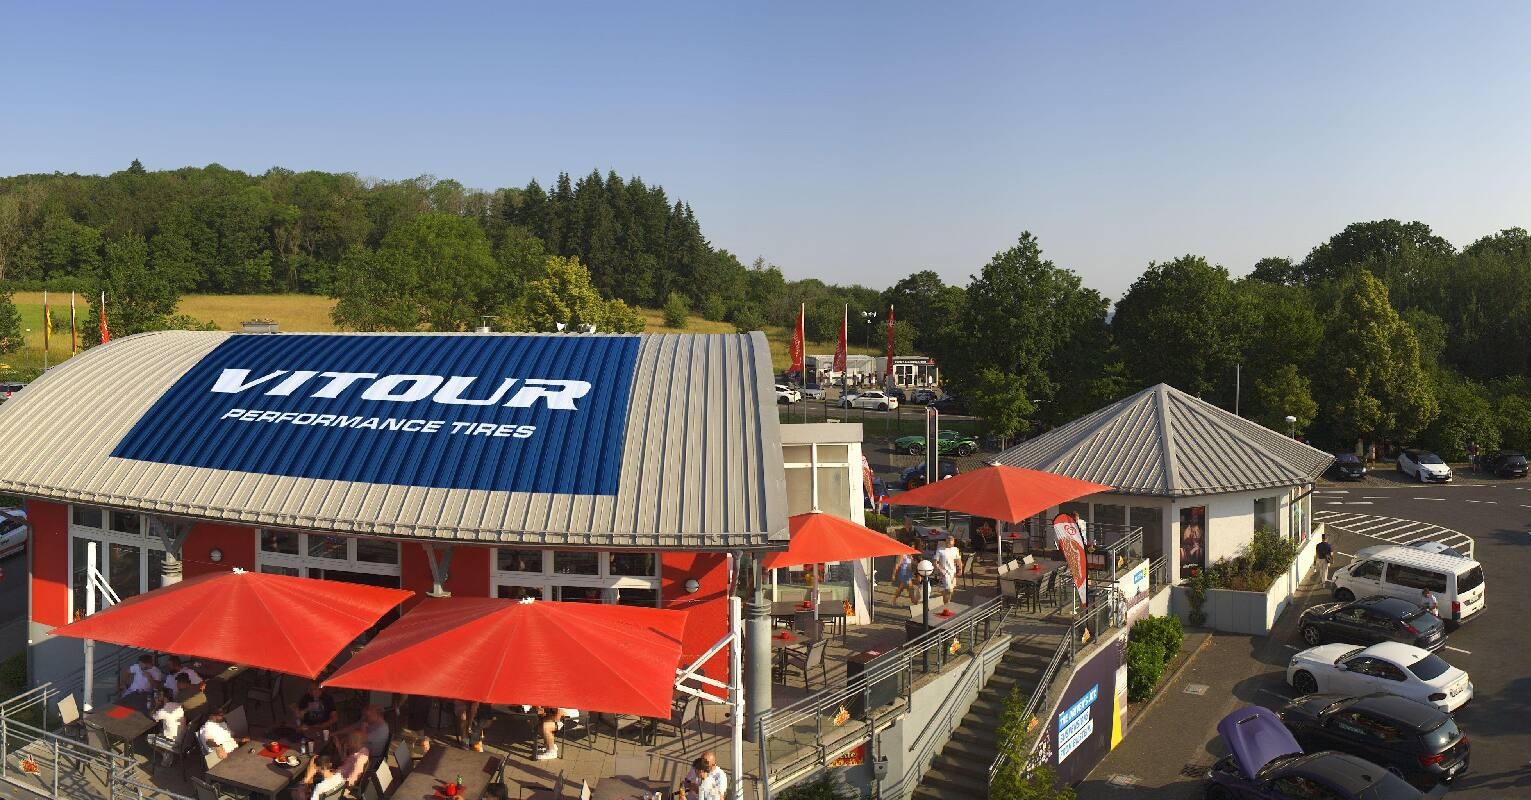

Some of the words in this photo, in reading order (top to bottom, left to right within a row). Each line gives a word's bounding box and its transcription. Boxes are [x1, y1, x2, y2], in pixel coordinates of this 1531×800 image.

[210, 368, 592, 411] VITOUR
[220, 408, 445, 433] PERFORMANCE
[450, 421, 537, 439] TIRES
